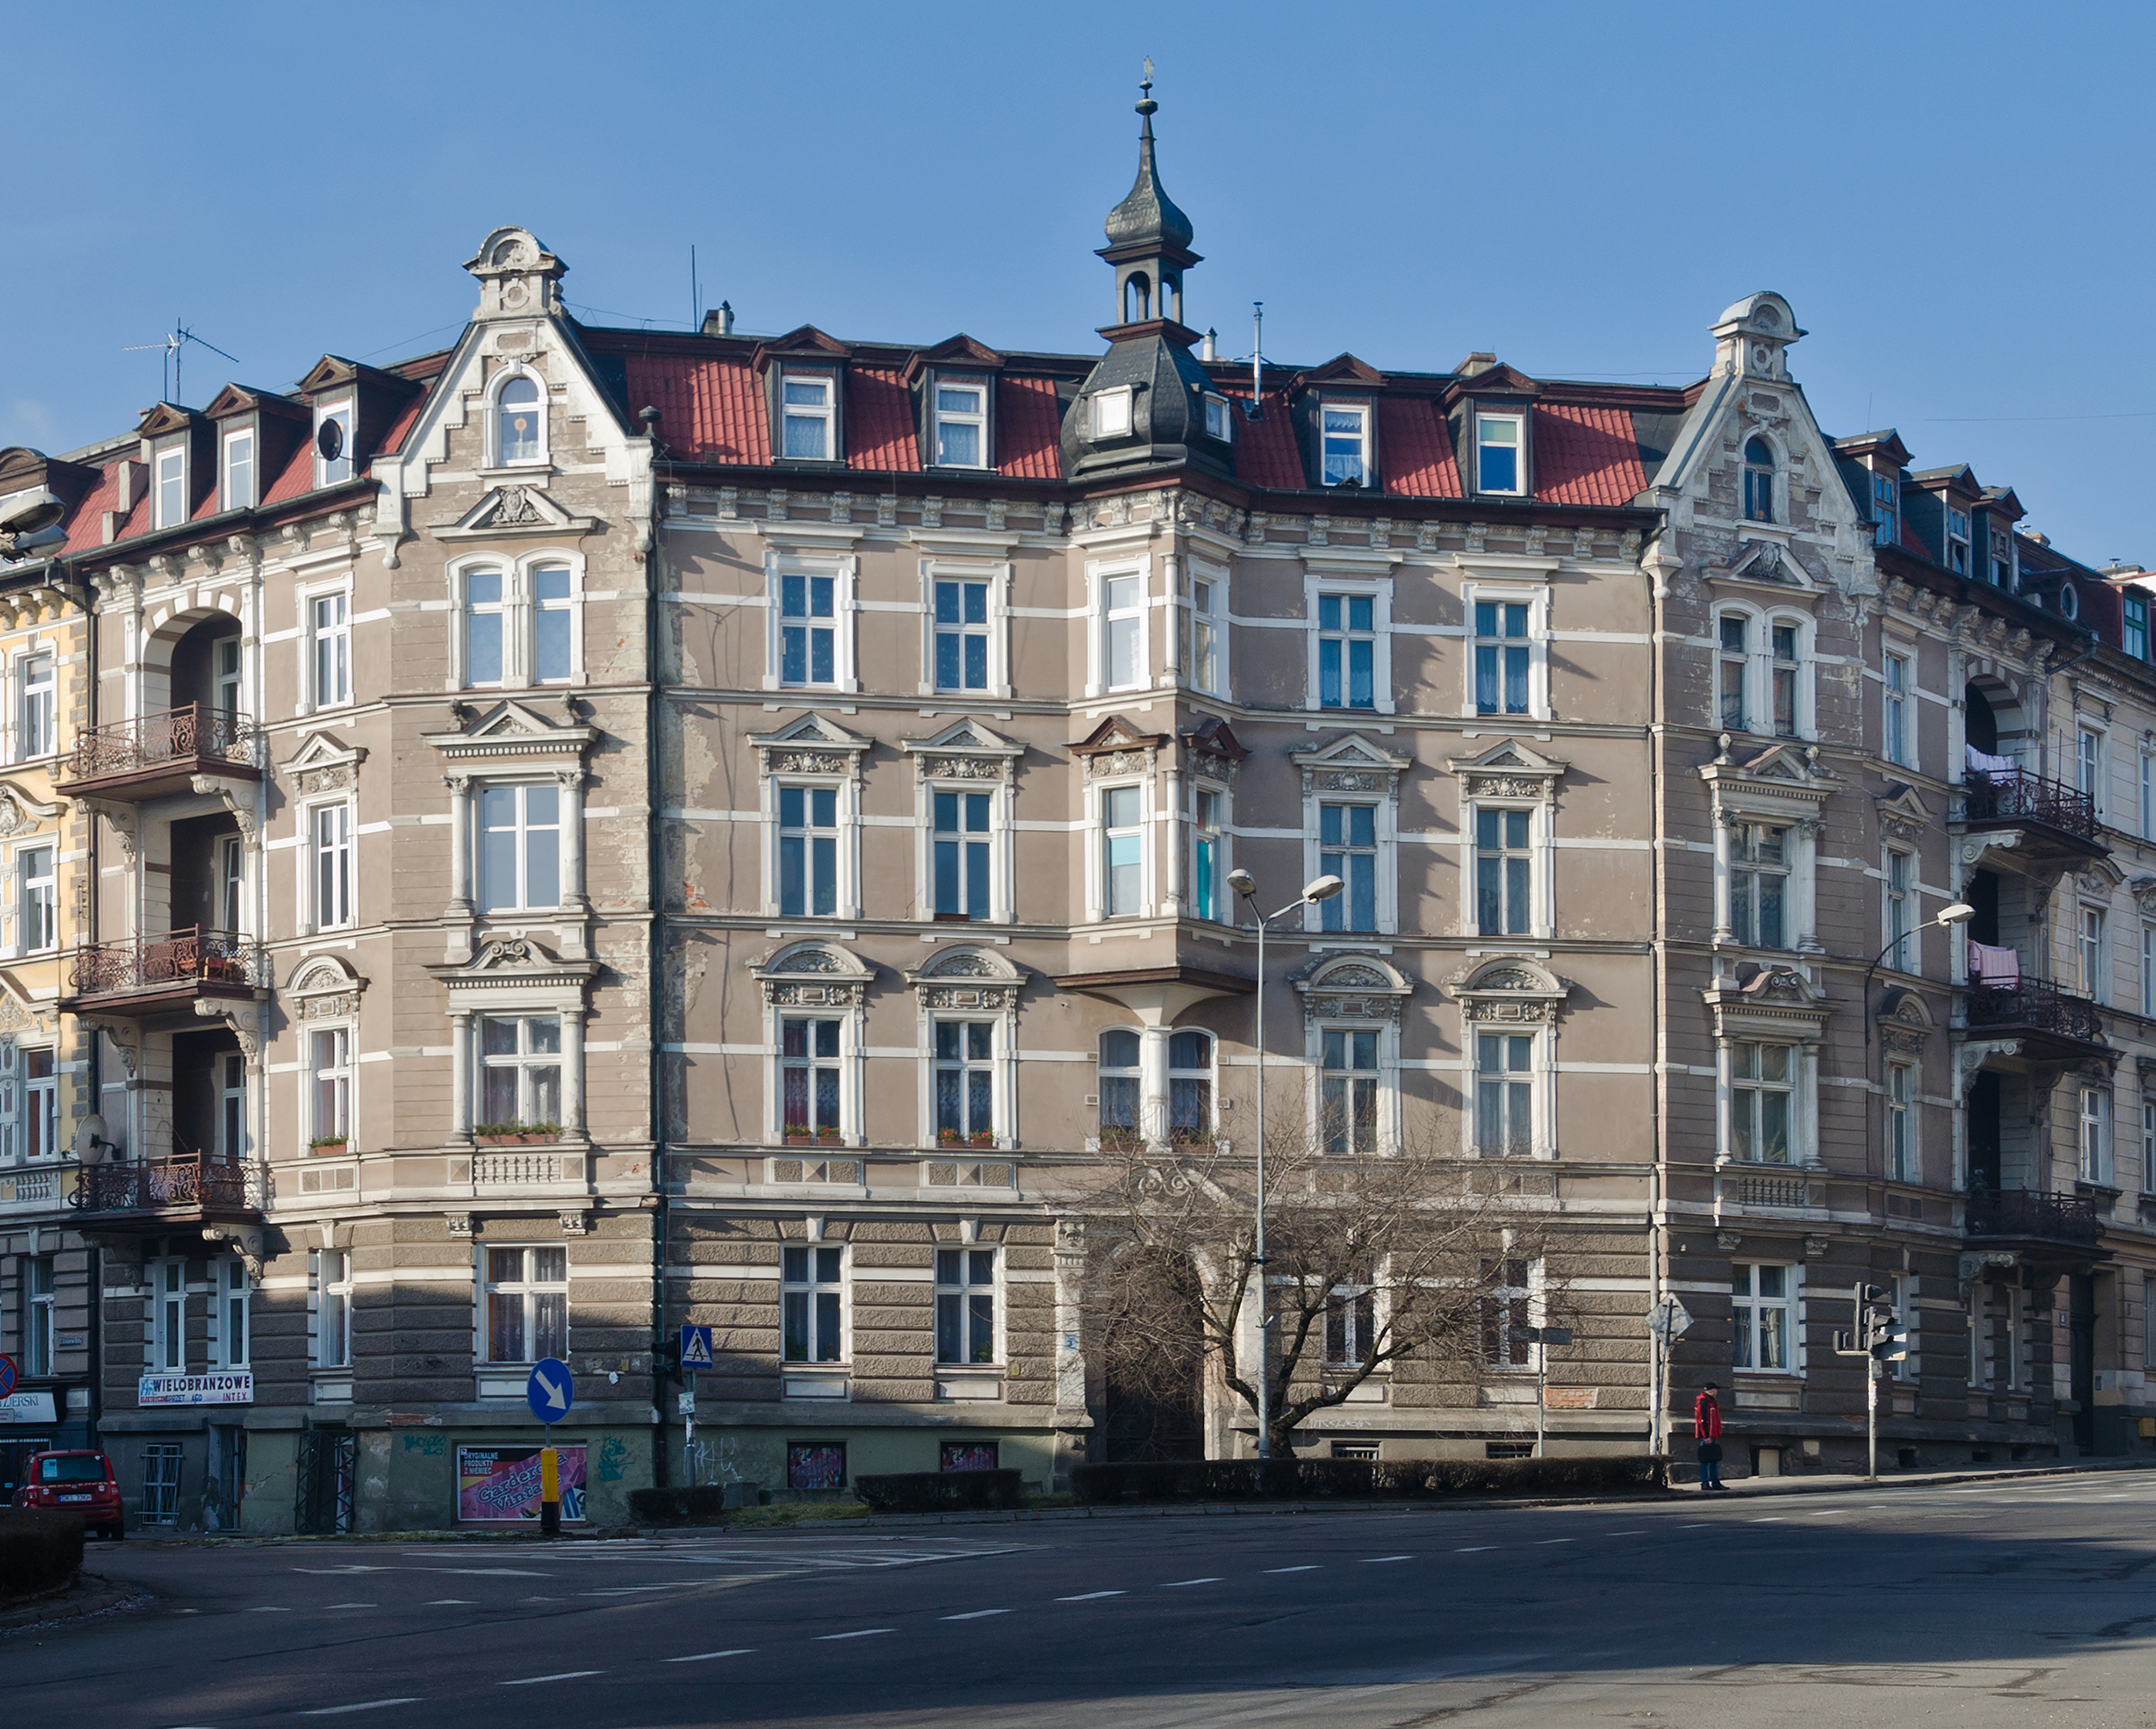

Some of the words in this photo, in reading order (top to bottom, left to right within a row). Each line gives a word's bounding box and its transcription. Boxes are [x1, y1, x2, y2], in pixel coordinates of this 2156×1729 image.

[153, 1376, 250, 1392] WIELOBRANŻOWE
[223, 1392, 247, 1402] INTEX
[464, 1452, 499, 1460] ORYGINALNE
[464, 1467, 468, 1475] Z
[469, 1467, 492, 1475] NIEMIEC
[477, 1452, 568, 1503] Garderoa
